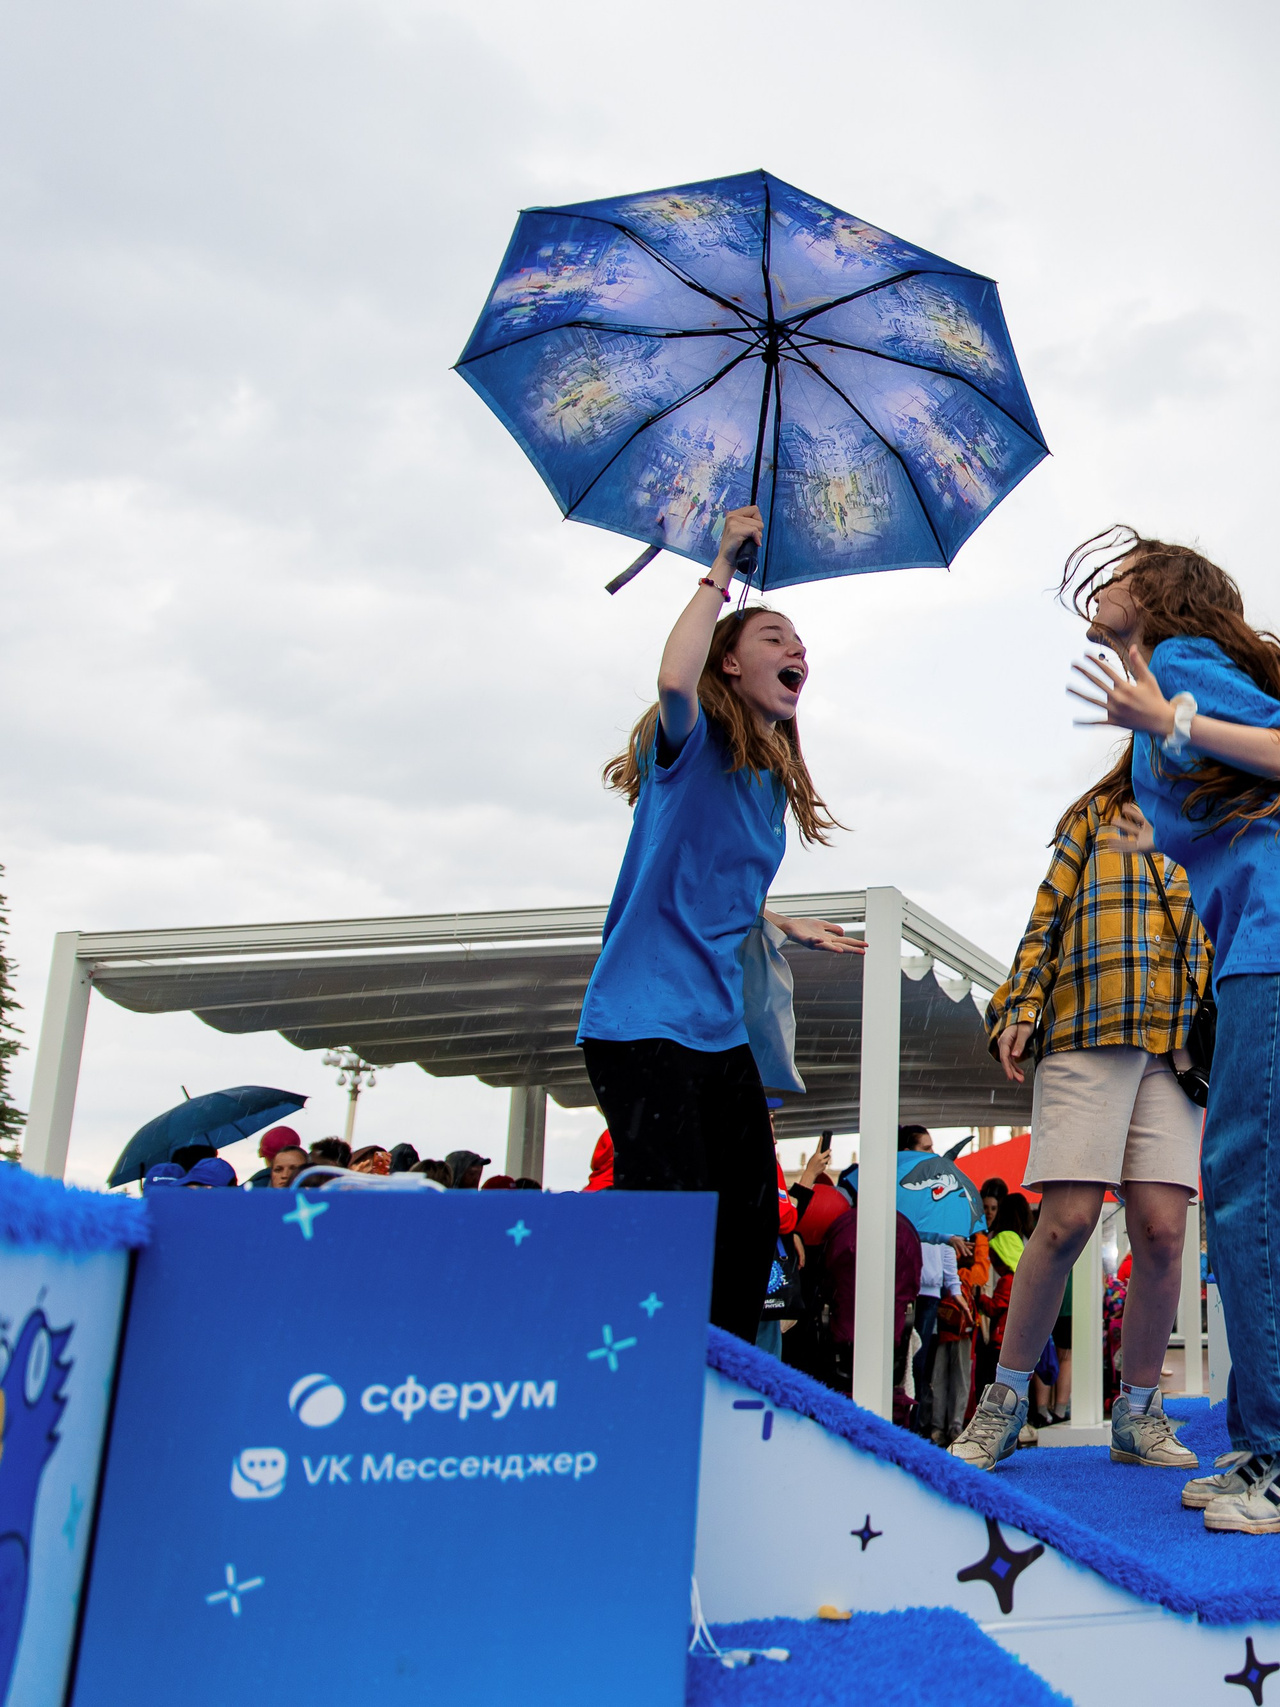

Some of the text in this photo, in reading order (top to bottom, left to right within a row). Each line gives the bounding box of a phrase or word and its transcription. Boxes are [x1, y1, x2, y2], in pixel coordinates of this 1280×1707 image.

[360, 1374, 558, 1423] сферум
[301, 1451, 598, 1486] VK Мессенджер
